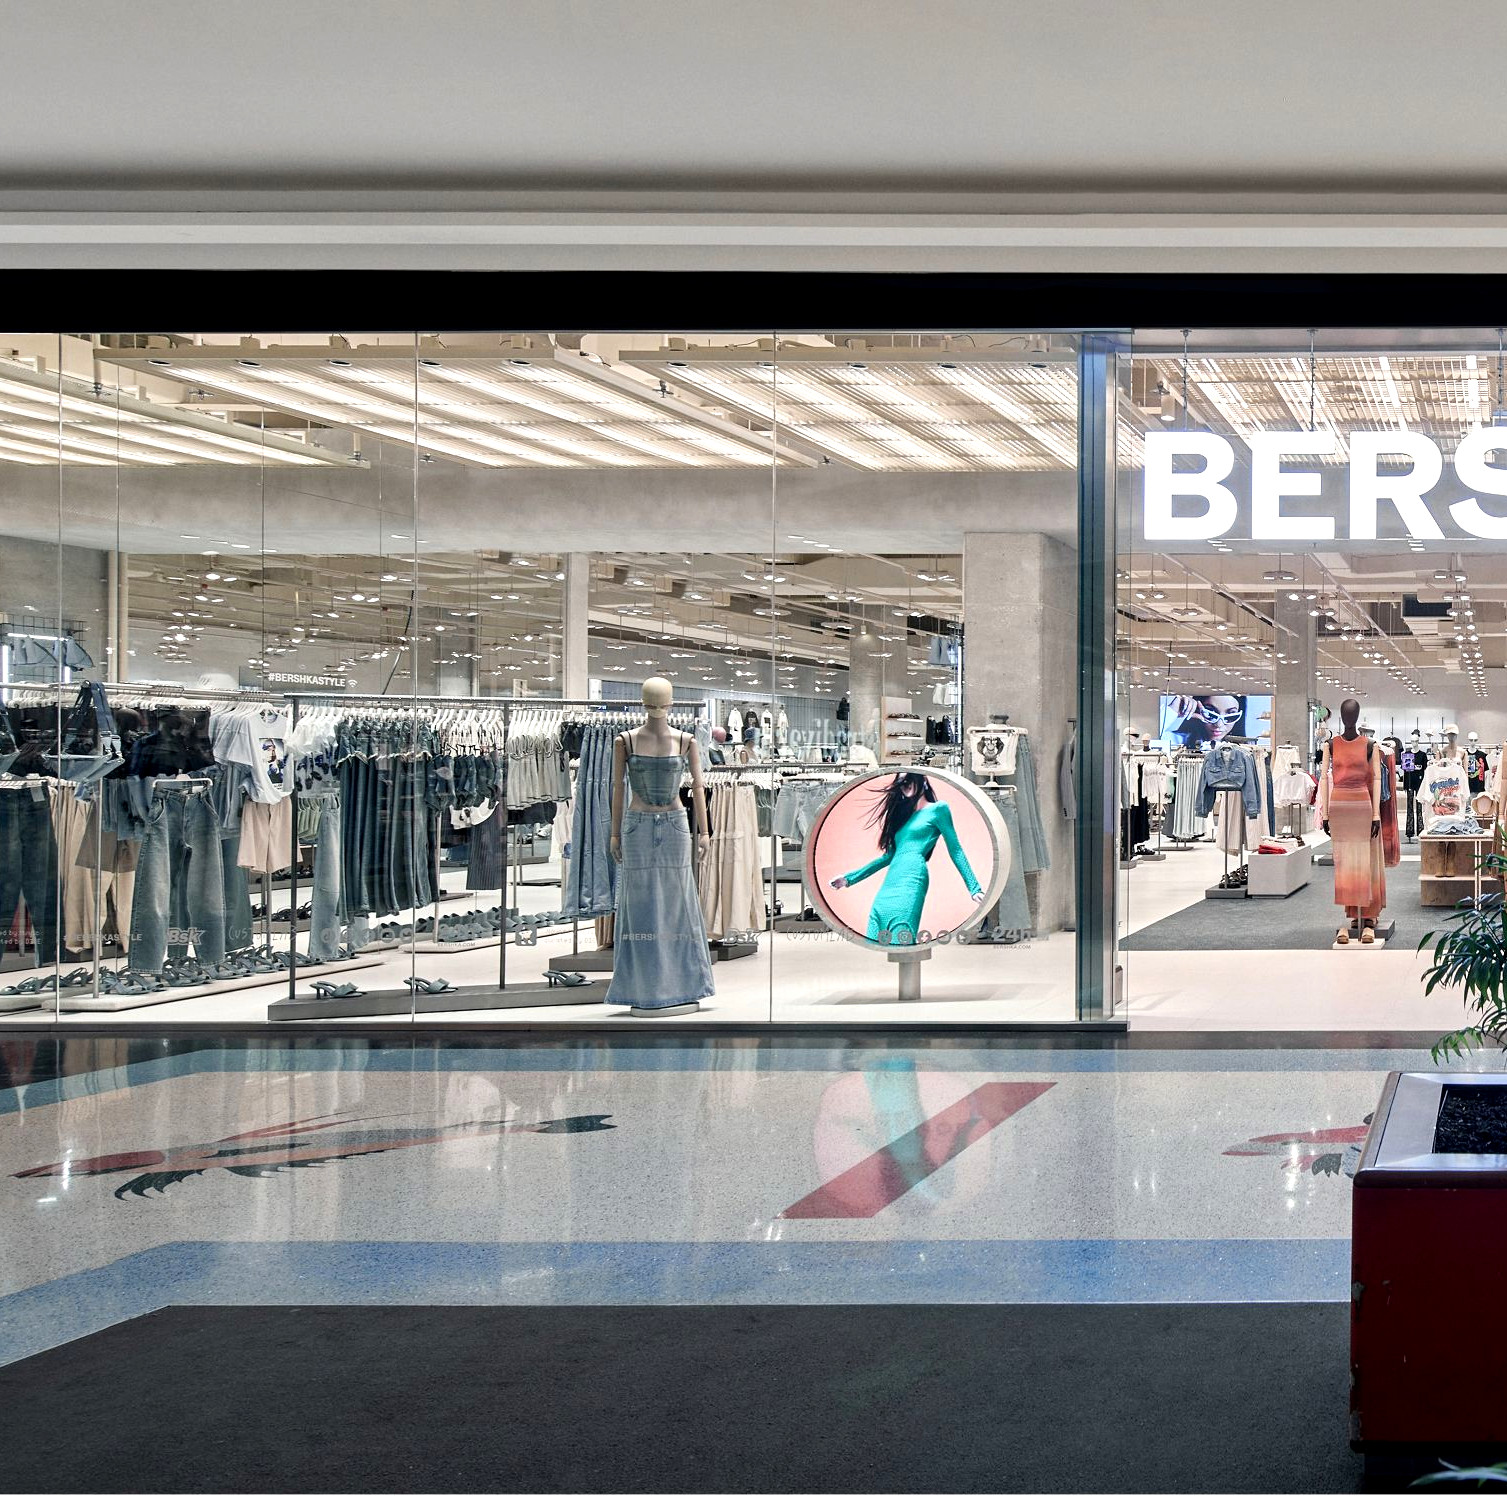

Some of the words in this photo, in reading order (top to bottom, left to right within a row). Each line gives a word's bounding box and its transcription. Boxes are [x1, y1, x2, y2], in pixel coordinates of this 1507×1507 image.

[267, 672, 346, 687] #BERSHKASTYLE
[167, 928, 201, 944] Bsk
[725, 928, 759, 945] Bsk
